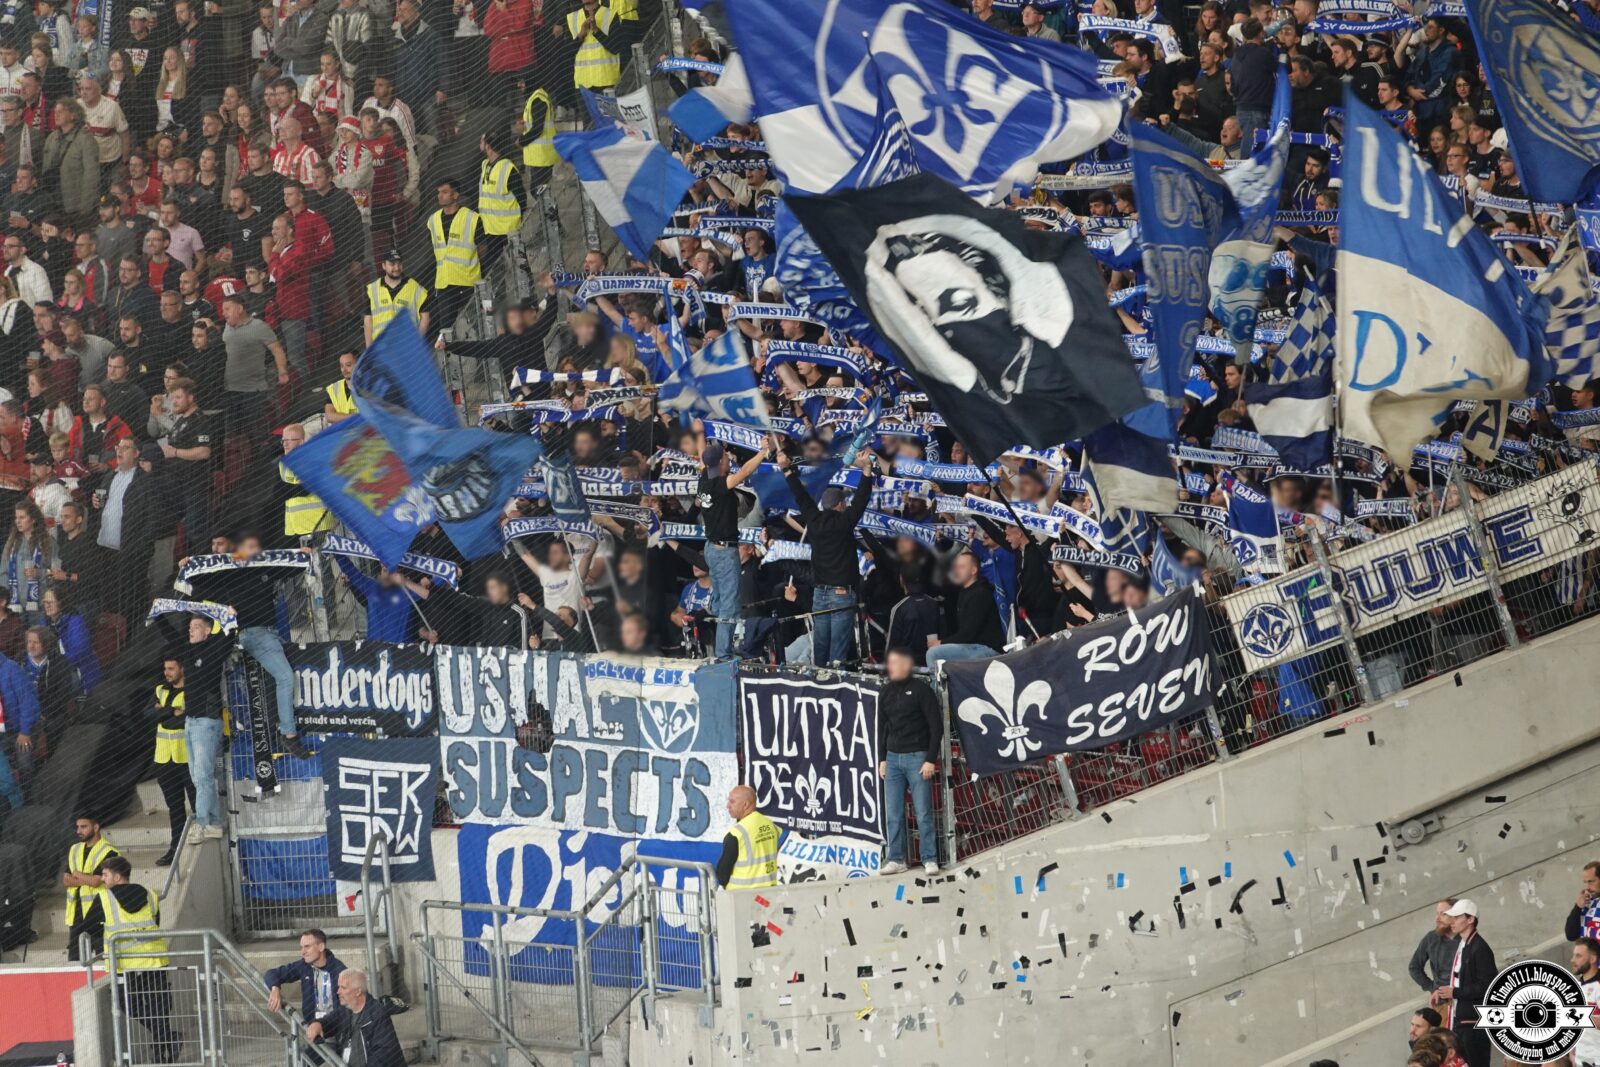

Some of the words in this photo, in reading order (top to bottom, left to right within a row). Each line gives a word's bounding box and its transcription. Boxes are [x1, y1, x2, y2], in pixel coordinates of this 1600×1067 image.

[602, 279, 672, 291] DARMSTADT
[737, 306, 809, 318] DARMSTADT
[650, 481, 698, 496] DOGS
[665, 524, 698, 536] USUAL
[1120, 555, 1141, 572] LIS
[1077, 604, 1190, 683] ROW
[1066, 653, 1213, 746] SEVEN
[330, 715, 347, 725] und
[349, 717, 377, 727] verein
[446, 741, 711, 838] SUSPECTS
[752, 760, 795, 812] DE
[831, 764, 877, 824] LIS
[780, 838, 880, 871] LILIENFANS
